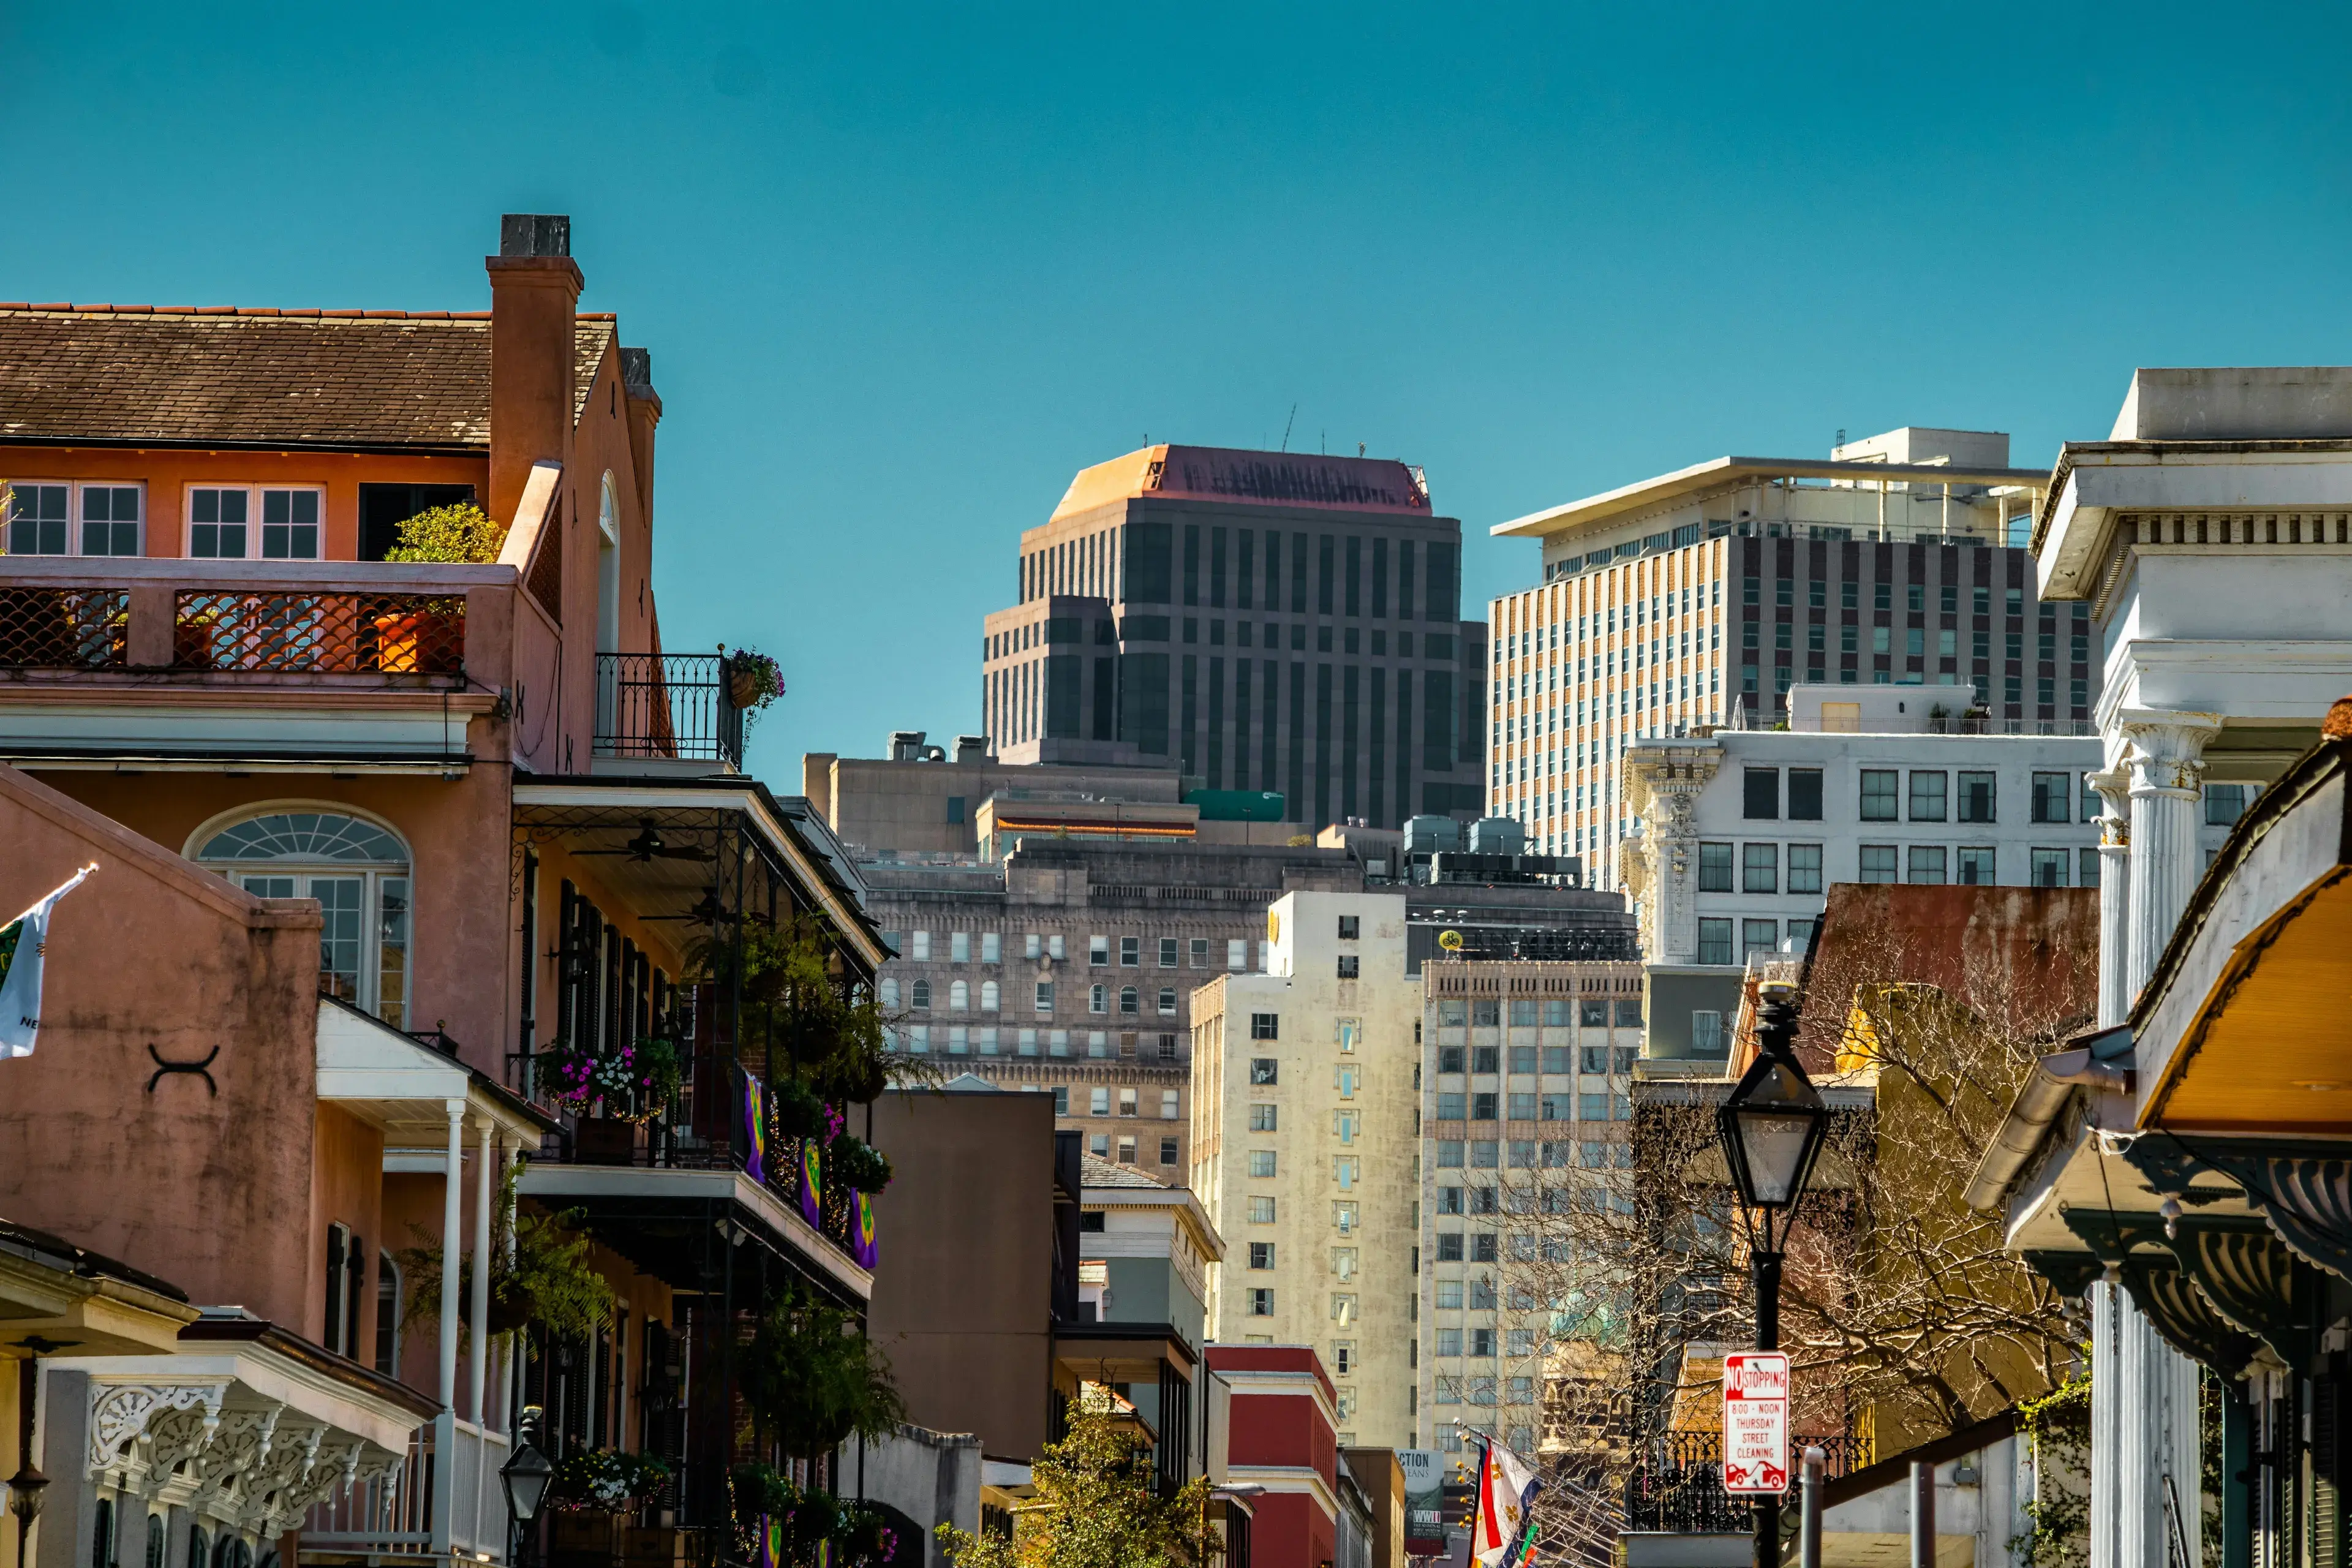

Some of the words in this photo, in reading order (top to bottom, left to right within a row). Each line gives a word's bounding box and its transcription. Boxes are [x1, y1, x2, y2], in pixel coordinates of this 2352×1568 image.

[1475, 932, 1627, 948] RENAISSANCE
[20, 1016, 39, 1030] NE
[1726, 1365, 1743, 1392] NO
[1744, 1371, 1785, 1389] STOPPING
[1732, 1404, 1748, 1414] 8:00
[1758, 1403, 1780, 1414] NOON
[1736, 1418, 1776, 1429] THURSDAY
[1743, 1433, 1769, 1444] STREET
[1737, 1447, 1774, 1458] CLEANING
[1399, 1453, 1429, 1468] CTION
[1408, 1469, 1429, 1477] EANS
[1414, 1510, 1441, 1523] WWII
